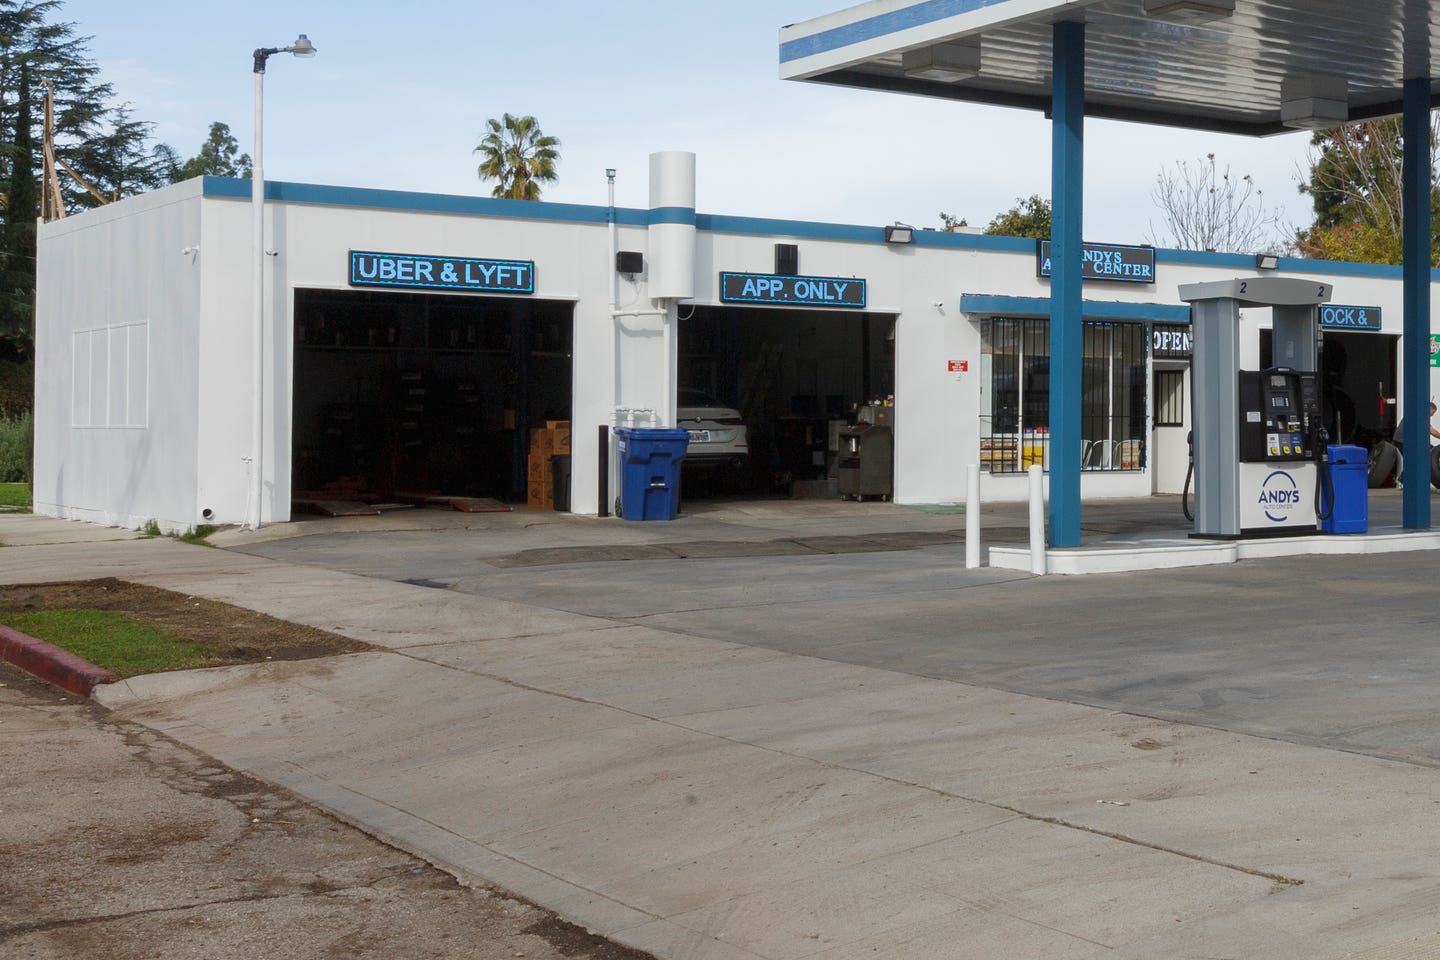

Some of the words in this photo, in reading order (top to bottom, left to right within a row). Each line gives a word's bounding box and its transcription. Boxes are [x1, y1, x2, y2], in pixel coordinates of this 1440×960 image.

[1082, 250, 1122, 264] NDYS
[359, 257, 434, 281] UBER
[440, 262, 458, 283] &
[465, 263, 527, 286] LYFT
[1093, 262, 1151, 277] CENTER
[742, 278, 788, 298] APP.
[794, 281, 848, 300] ONLY
[1240, 282, 1247, 294] 2
[1317, 286, 1325, 297] 2
[1358, 309, 1368, 326] &
[1258, 490, 1300, 504] ANDYS
